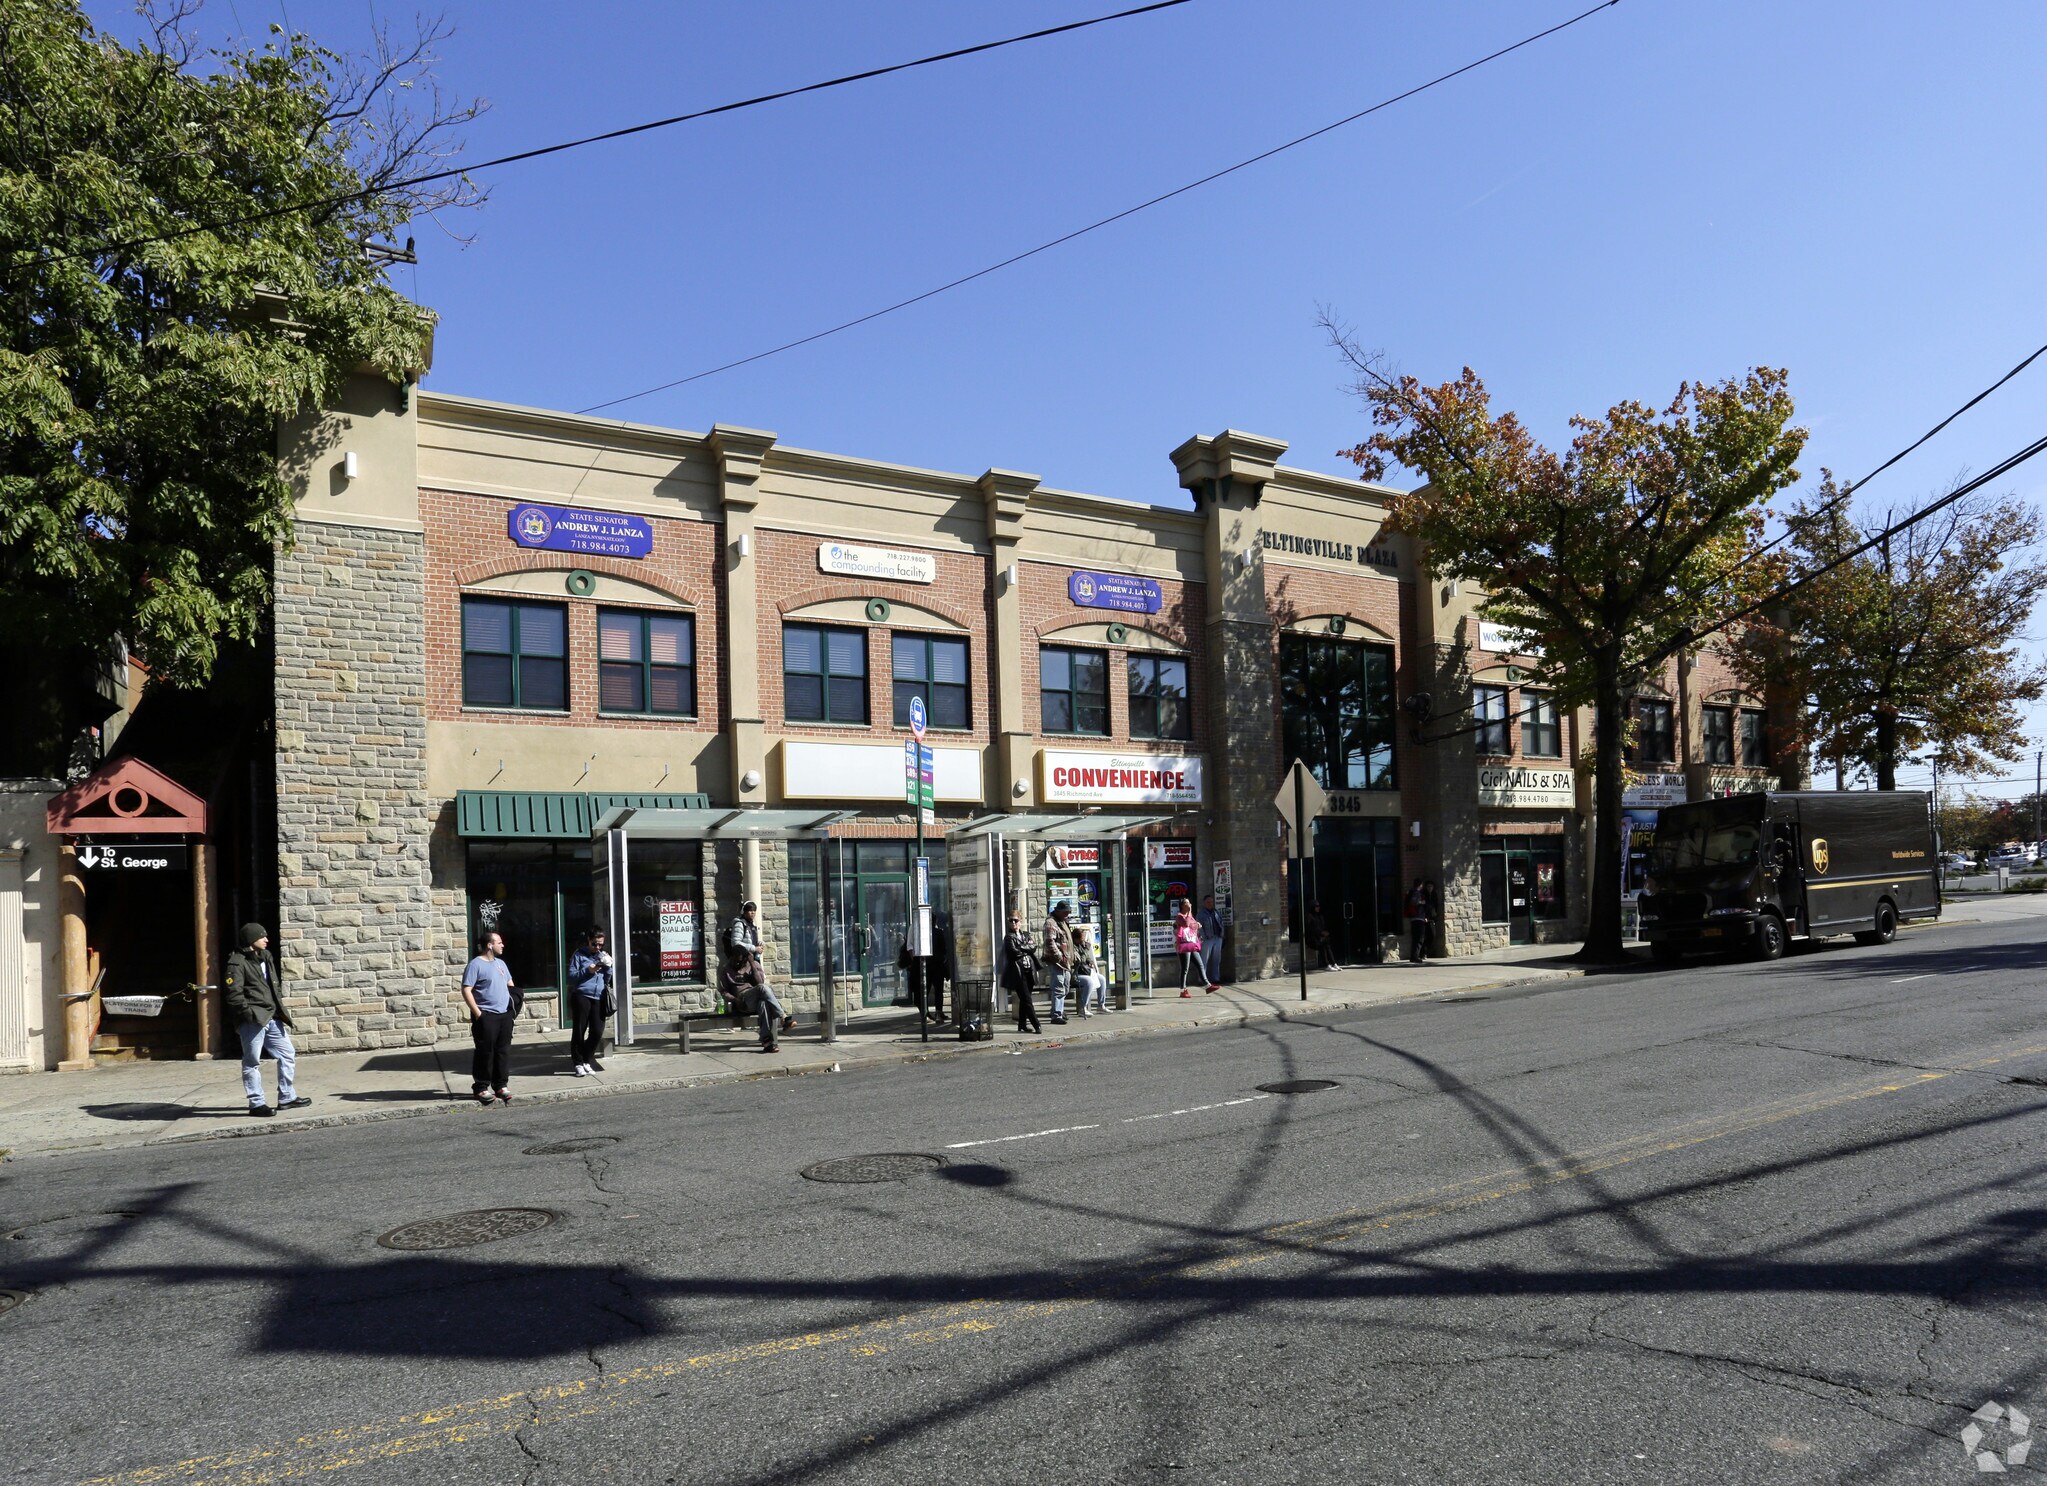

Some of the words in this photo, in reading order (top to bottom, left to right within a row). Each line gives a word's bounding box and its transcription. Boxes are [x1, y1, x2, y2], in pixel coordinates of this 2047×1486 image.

[570, 512, 593, 522] STATE
[594, 515, 629, 526] SENATOR
[555, 521, 599, 533] ANDREW
[601, 526, 609, 535] J.
[611, 527, 644, 538] LANZA
[570, 540, 630, 554] 718.984.4073
[1263, 531, 1353, 562] ELTINGVILLE
[1357, 546, 1398, 568] PLAZA
[844, 549, 859, 561] the
[831, 560, 895, 577] compounding
[897, 564, 926, 580] facility
[1108, 577, 1123, 585] STATE
[1098, 584, 1128, 594] ANDREW
[1135, 588, 1157, 598] LANZA
[1110, 758, 1145, 769] Eltingville
[1053, 767, 1184, 790] CONVENIENCE
[1480, 770, 1502, 788] Cici
[1506, 772, 1538, 788] NAILS
[1540, 776, 1550, 788] &
[1552, 774, 1570, 789] SPA
[1664, 775, 1686, 787] WORLD
[1066, 790, 1092, 798] Richmond
[1330, 796, 1361, 813] 3845
[1629, 832, 1656, 847] DIREC
[100, 847, 116, 857] To
[1068, 850, 1098, 861] GYROS
[1892, 851, 1910, 859] Worldwide
[1910, 850, 1925, 858] Services
[100, 857, 118, 868] St.
[122, 857, 168, 869] George
[661, 902, 698, 912] RETAIL
[662, 915, 697, 925] SPACE
